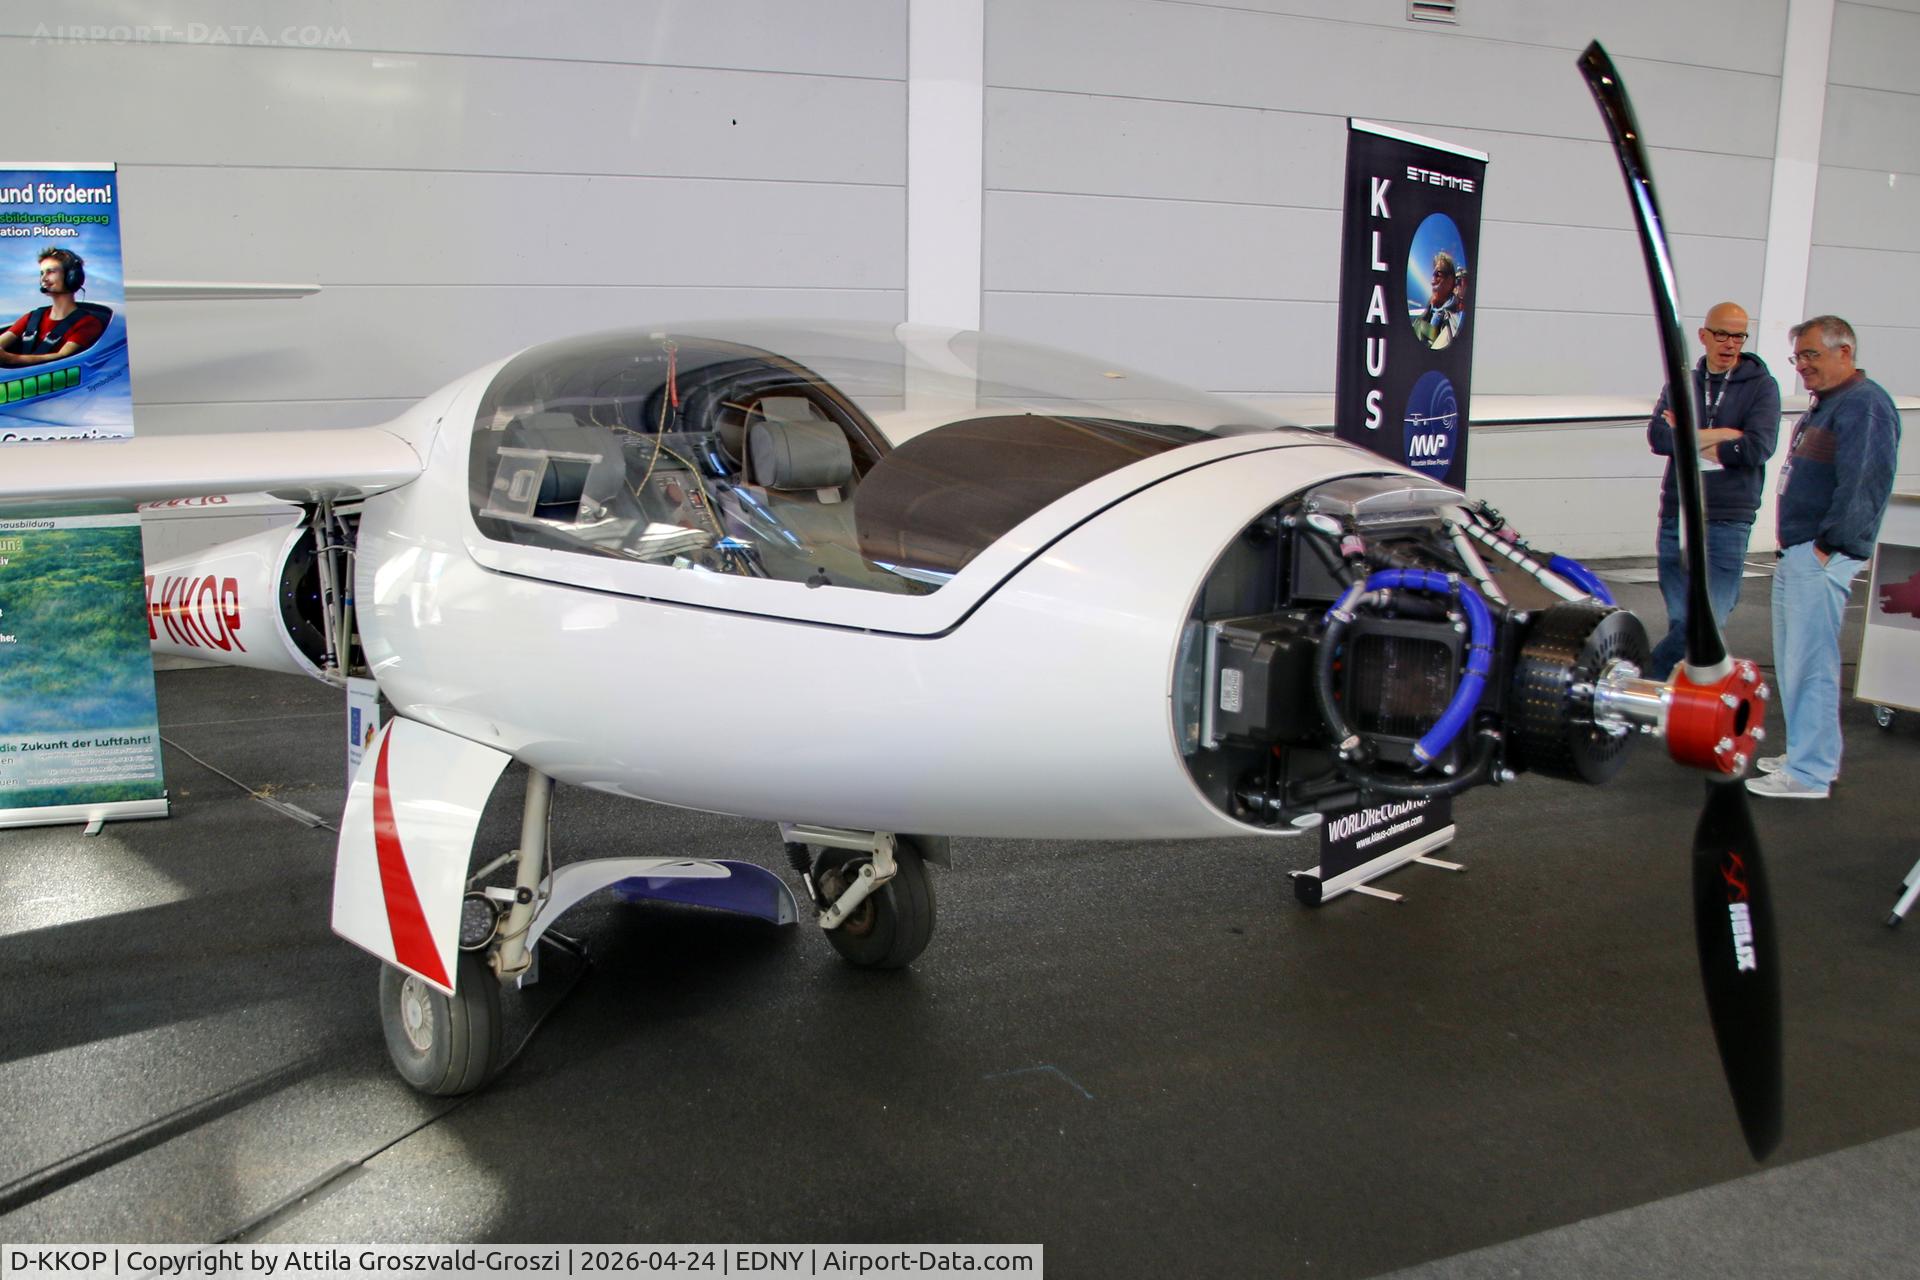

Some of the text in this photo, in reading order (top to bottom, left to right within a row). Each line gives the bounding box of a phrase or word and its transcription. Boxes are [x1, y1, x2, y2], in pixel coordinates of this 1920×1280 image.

[1407, 166, 1474, 192] STEMME
[0, 183, 112, 204] und fördern!
[0, 226, 79, 237] ation Piloten.
[1365, 176, 1391, 430] KLAUS
[0, 736, 151, 752] die Zukunft der Luftfahrt!
